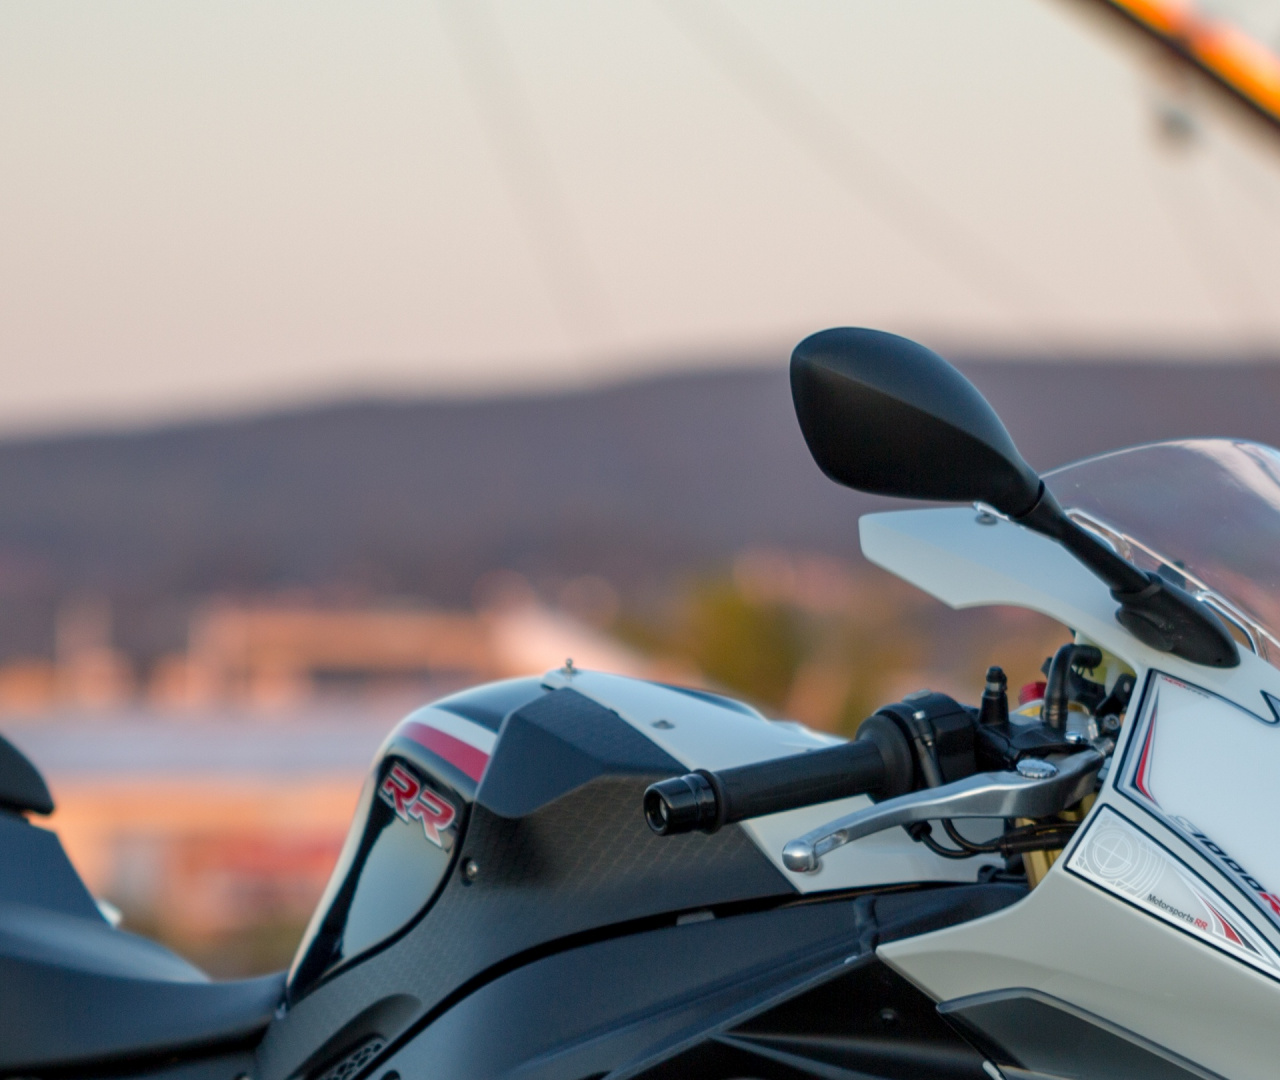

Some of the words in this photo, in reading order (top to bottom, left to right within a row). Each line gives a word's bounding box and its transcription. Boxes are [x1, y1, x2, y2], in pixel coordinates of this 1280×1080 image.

[380, 764, 456, 847] RR
[1147, 893, 1195, 926] Motorsports
[1193, 916, 1209, 931] RR
